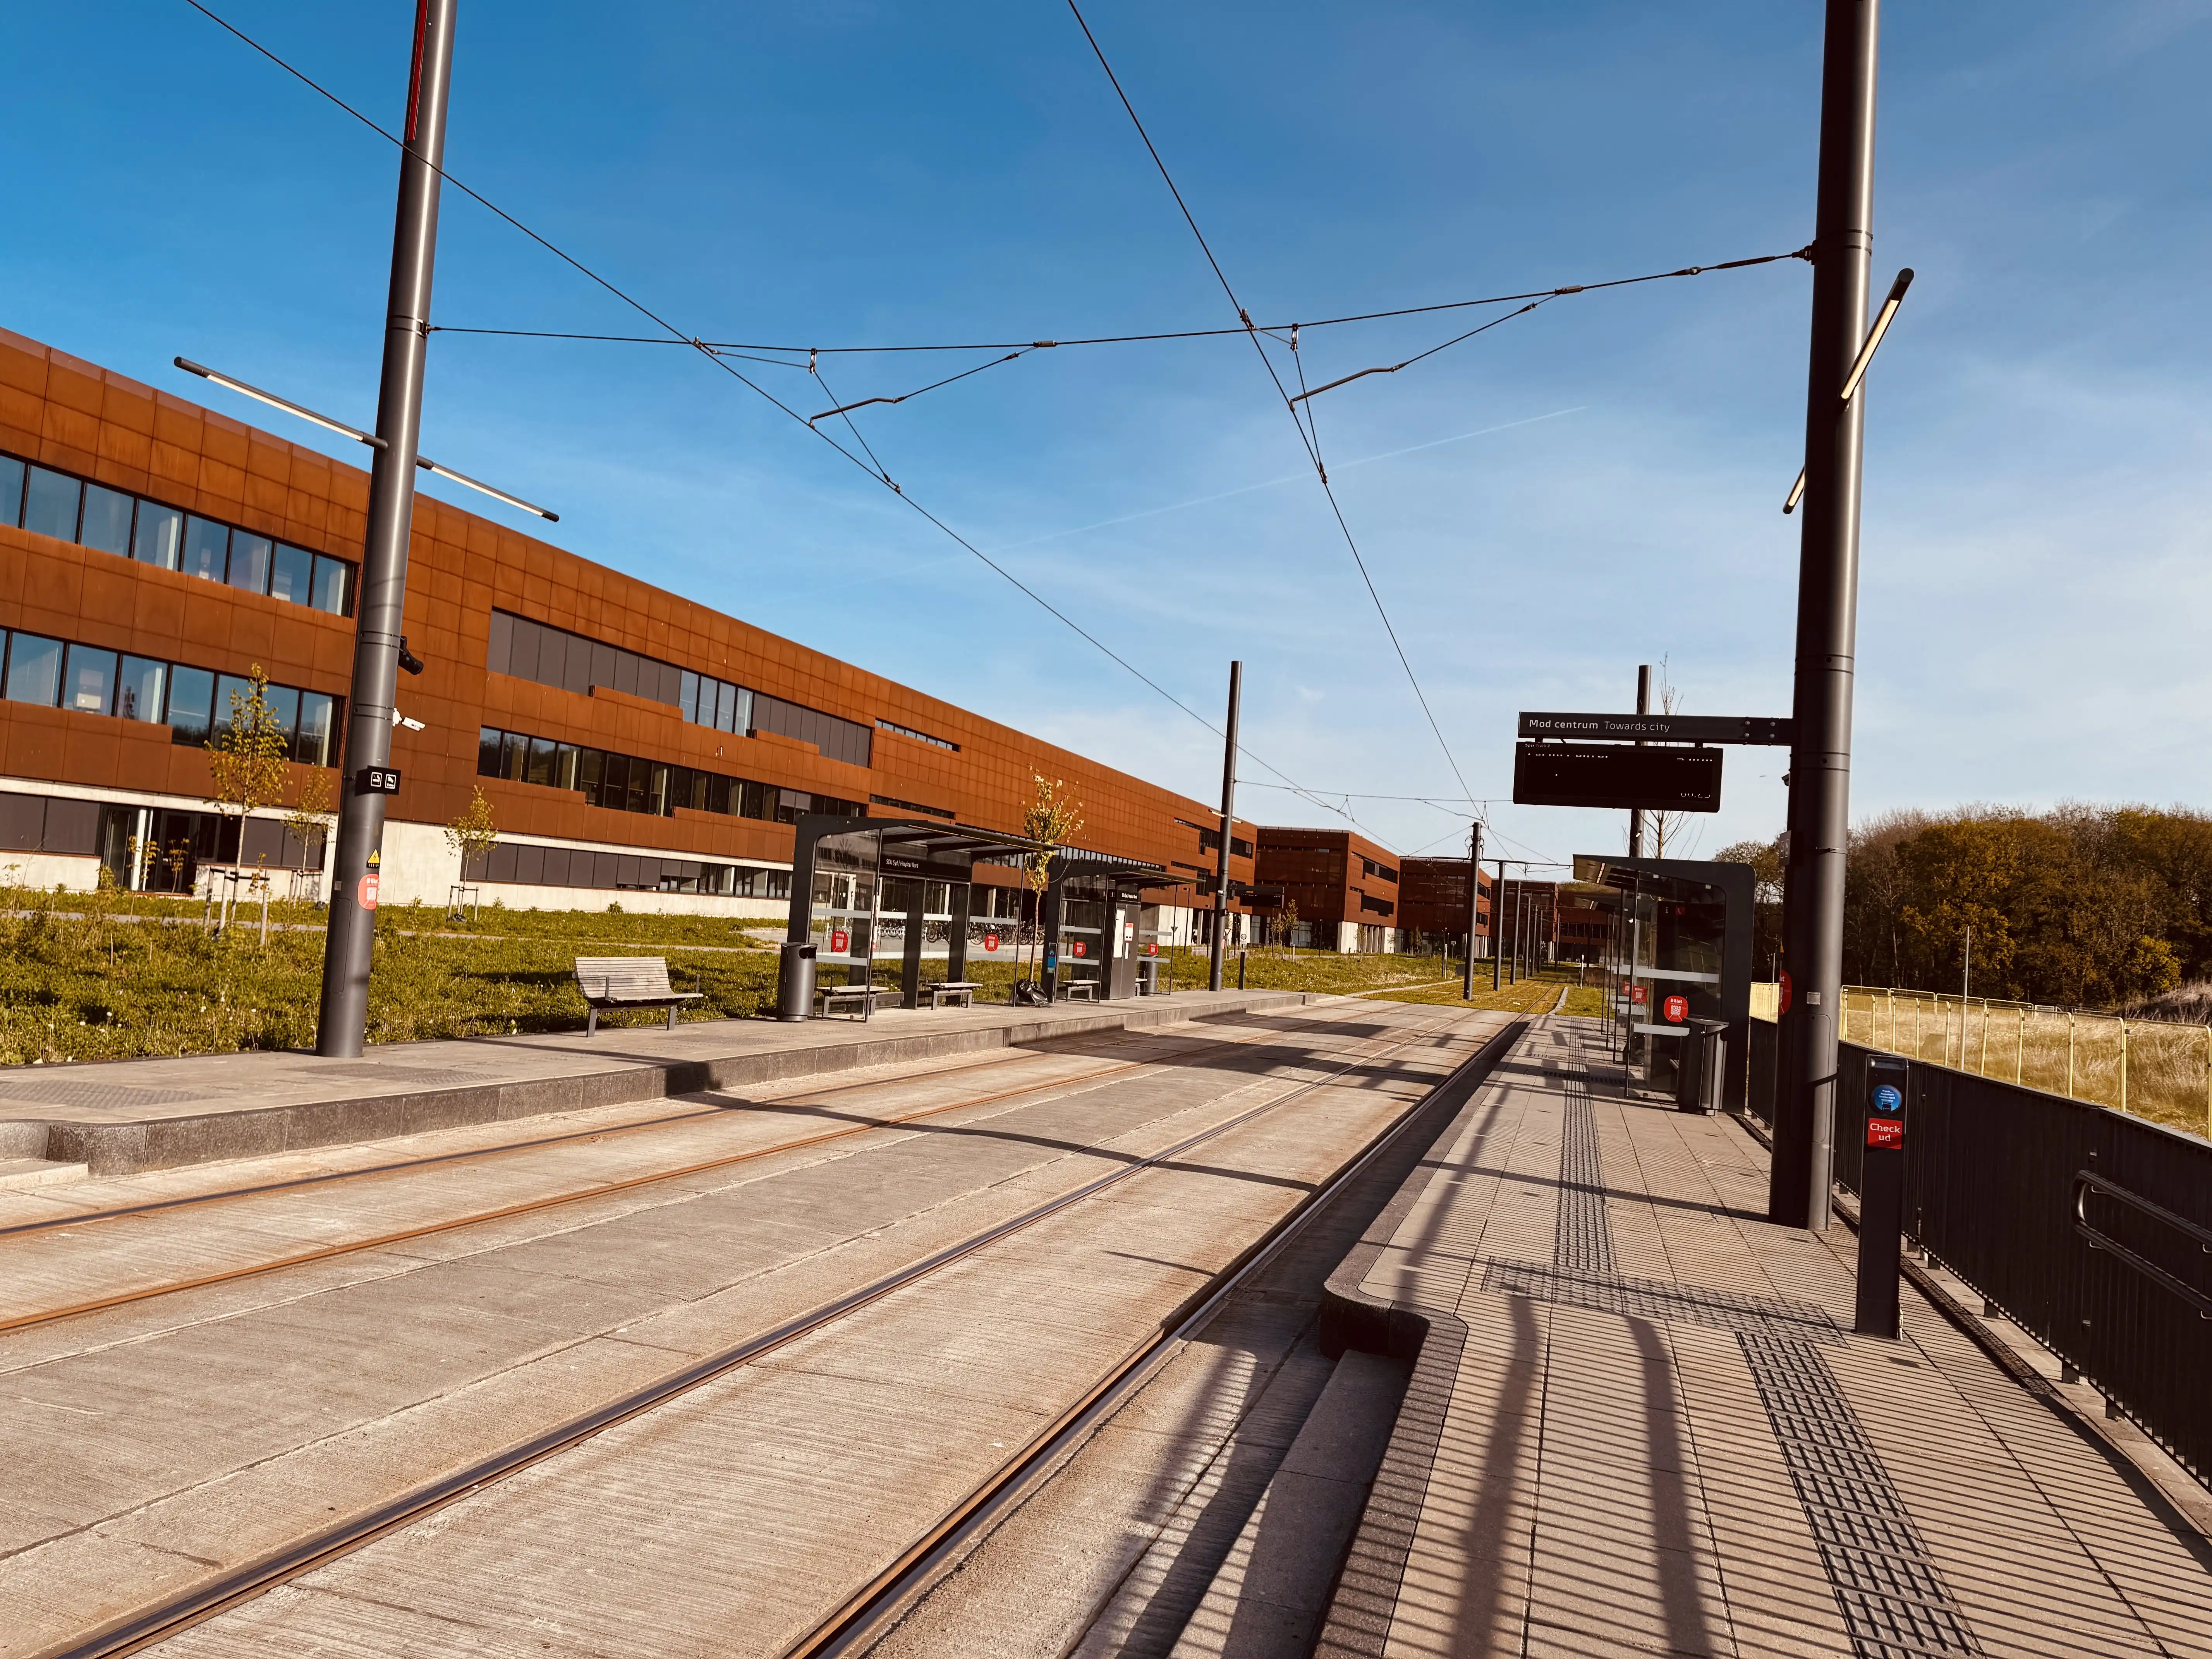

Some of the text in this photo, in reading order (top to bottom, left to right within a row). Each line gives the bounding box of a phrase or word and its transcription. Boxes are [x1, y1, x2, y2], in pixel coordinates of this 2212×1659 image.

[1529, 719, 1670, 733] Mod centrum Towards city
[1870, 1123, 1900, 1133] Check
